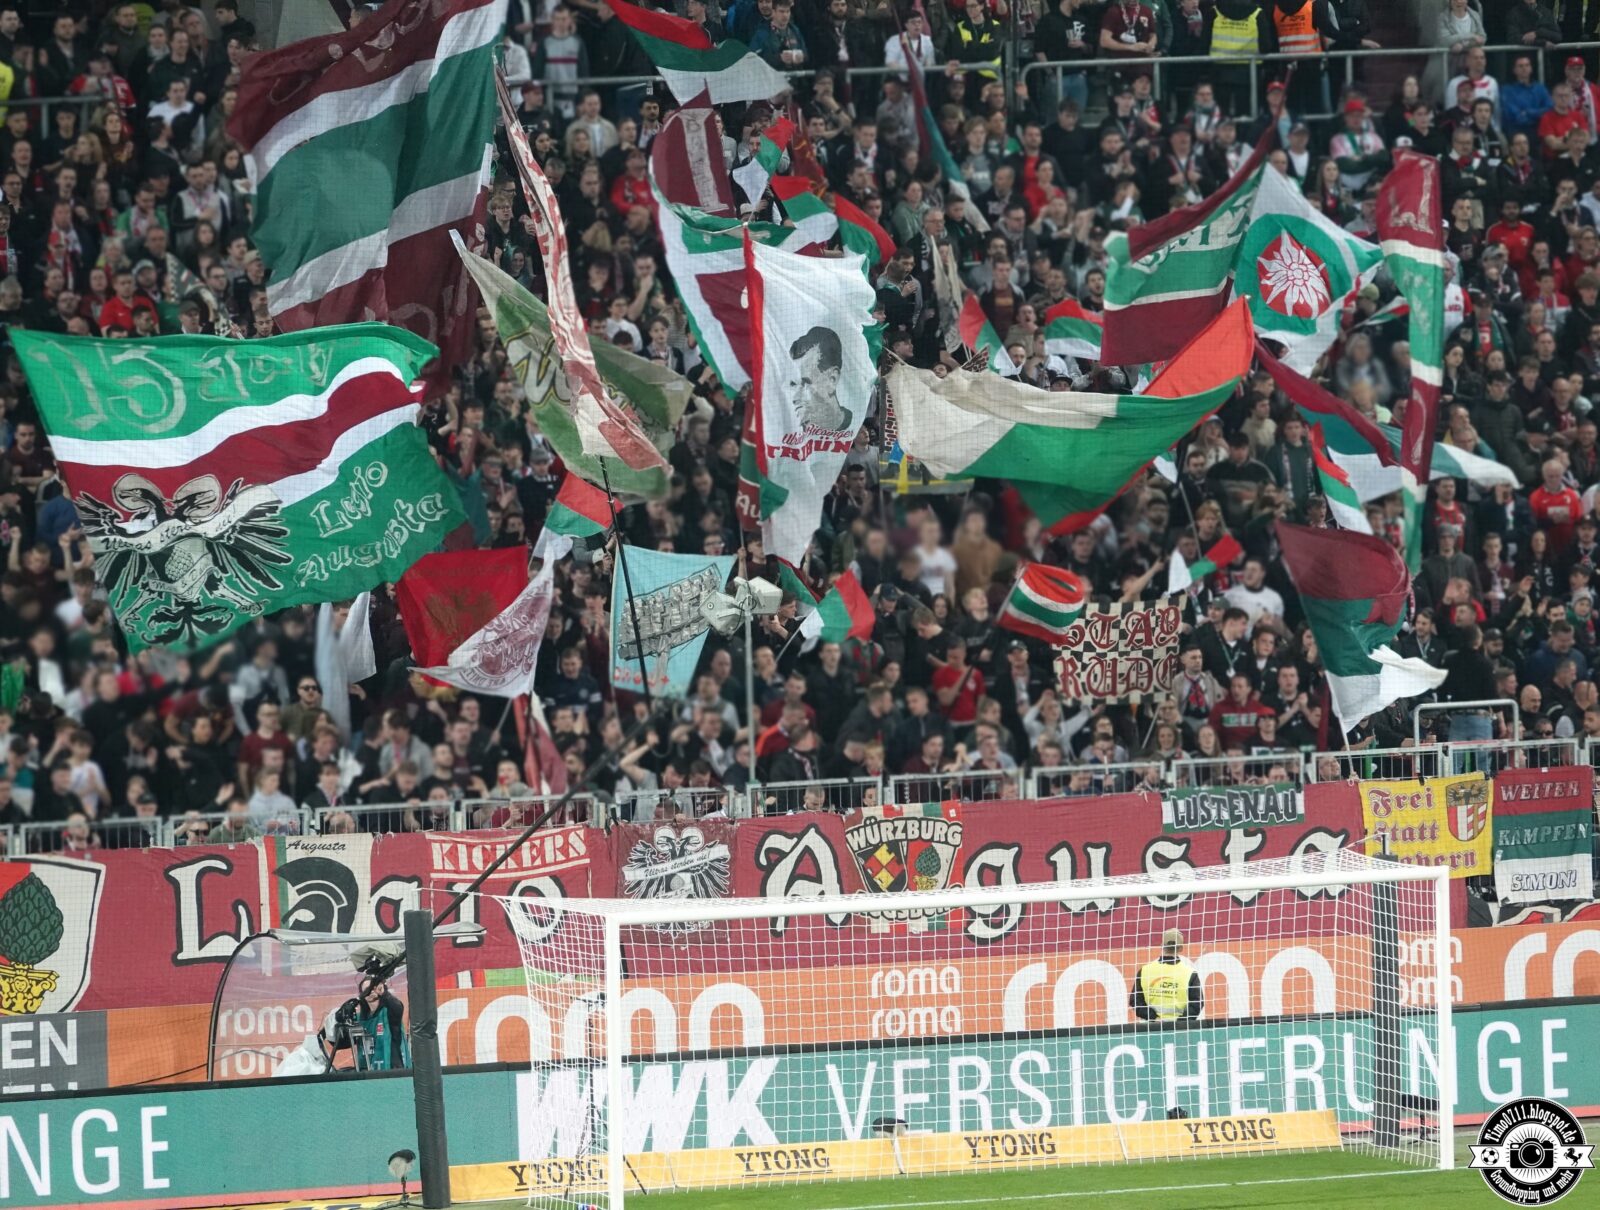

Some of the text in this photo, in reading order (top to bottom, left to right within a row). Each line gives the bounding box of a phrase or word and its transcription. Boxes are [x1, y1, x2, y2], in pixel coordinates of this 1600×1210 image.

[295, 492, 448, 587] Augusta
[1368, 786, 1435, 818] Frei
[1500, 780, 1581, 802] WEITER
[1170, 787, 1299, 830] LUSTENAU
[286, 839, 347, 854] Augusta
[845, 816, 963, 852] WÜRZBURG
[1498, 822, 1589, 846] KÄMPFEN
[431, 829, 588, 872] KICKERS
[643, 865, 668, 878] Ultras
[1510, 869, 1577, 892] SIMON!
[870, 965, 962, 999] roma
[219, 1004, 314, 1038] roma
[870, 1005, 962, 1039] roma
[515, 1057, 782, 1161] WWK
[963, 1132, 1057, 1160] YTONG
[1184, 1117, 1277, 1145] YTONG
[508, 1158, 607, 1189] YTONG
[736, 1147, 832, 1174] YTONG
